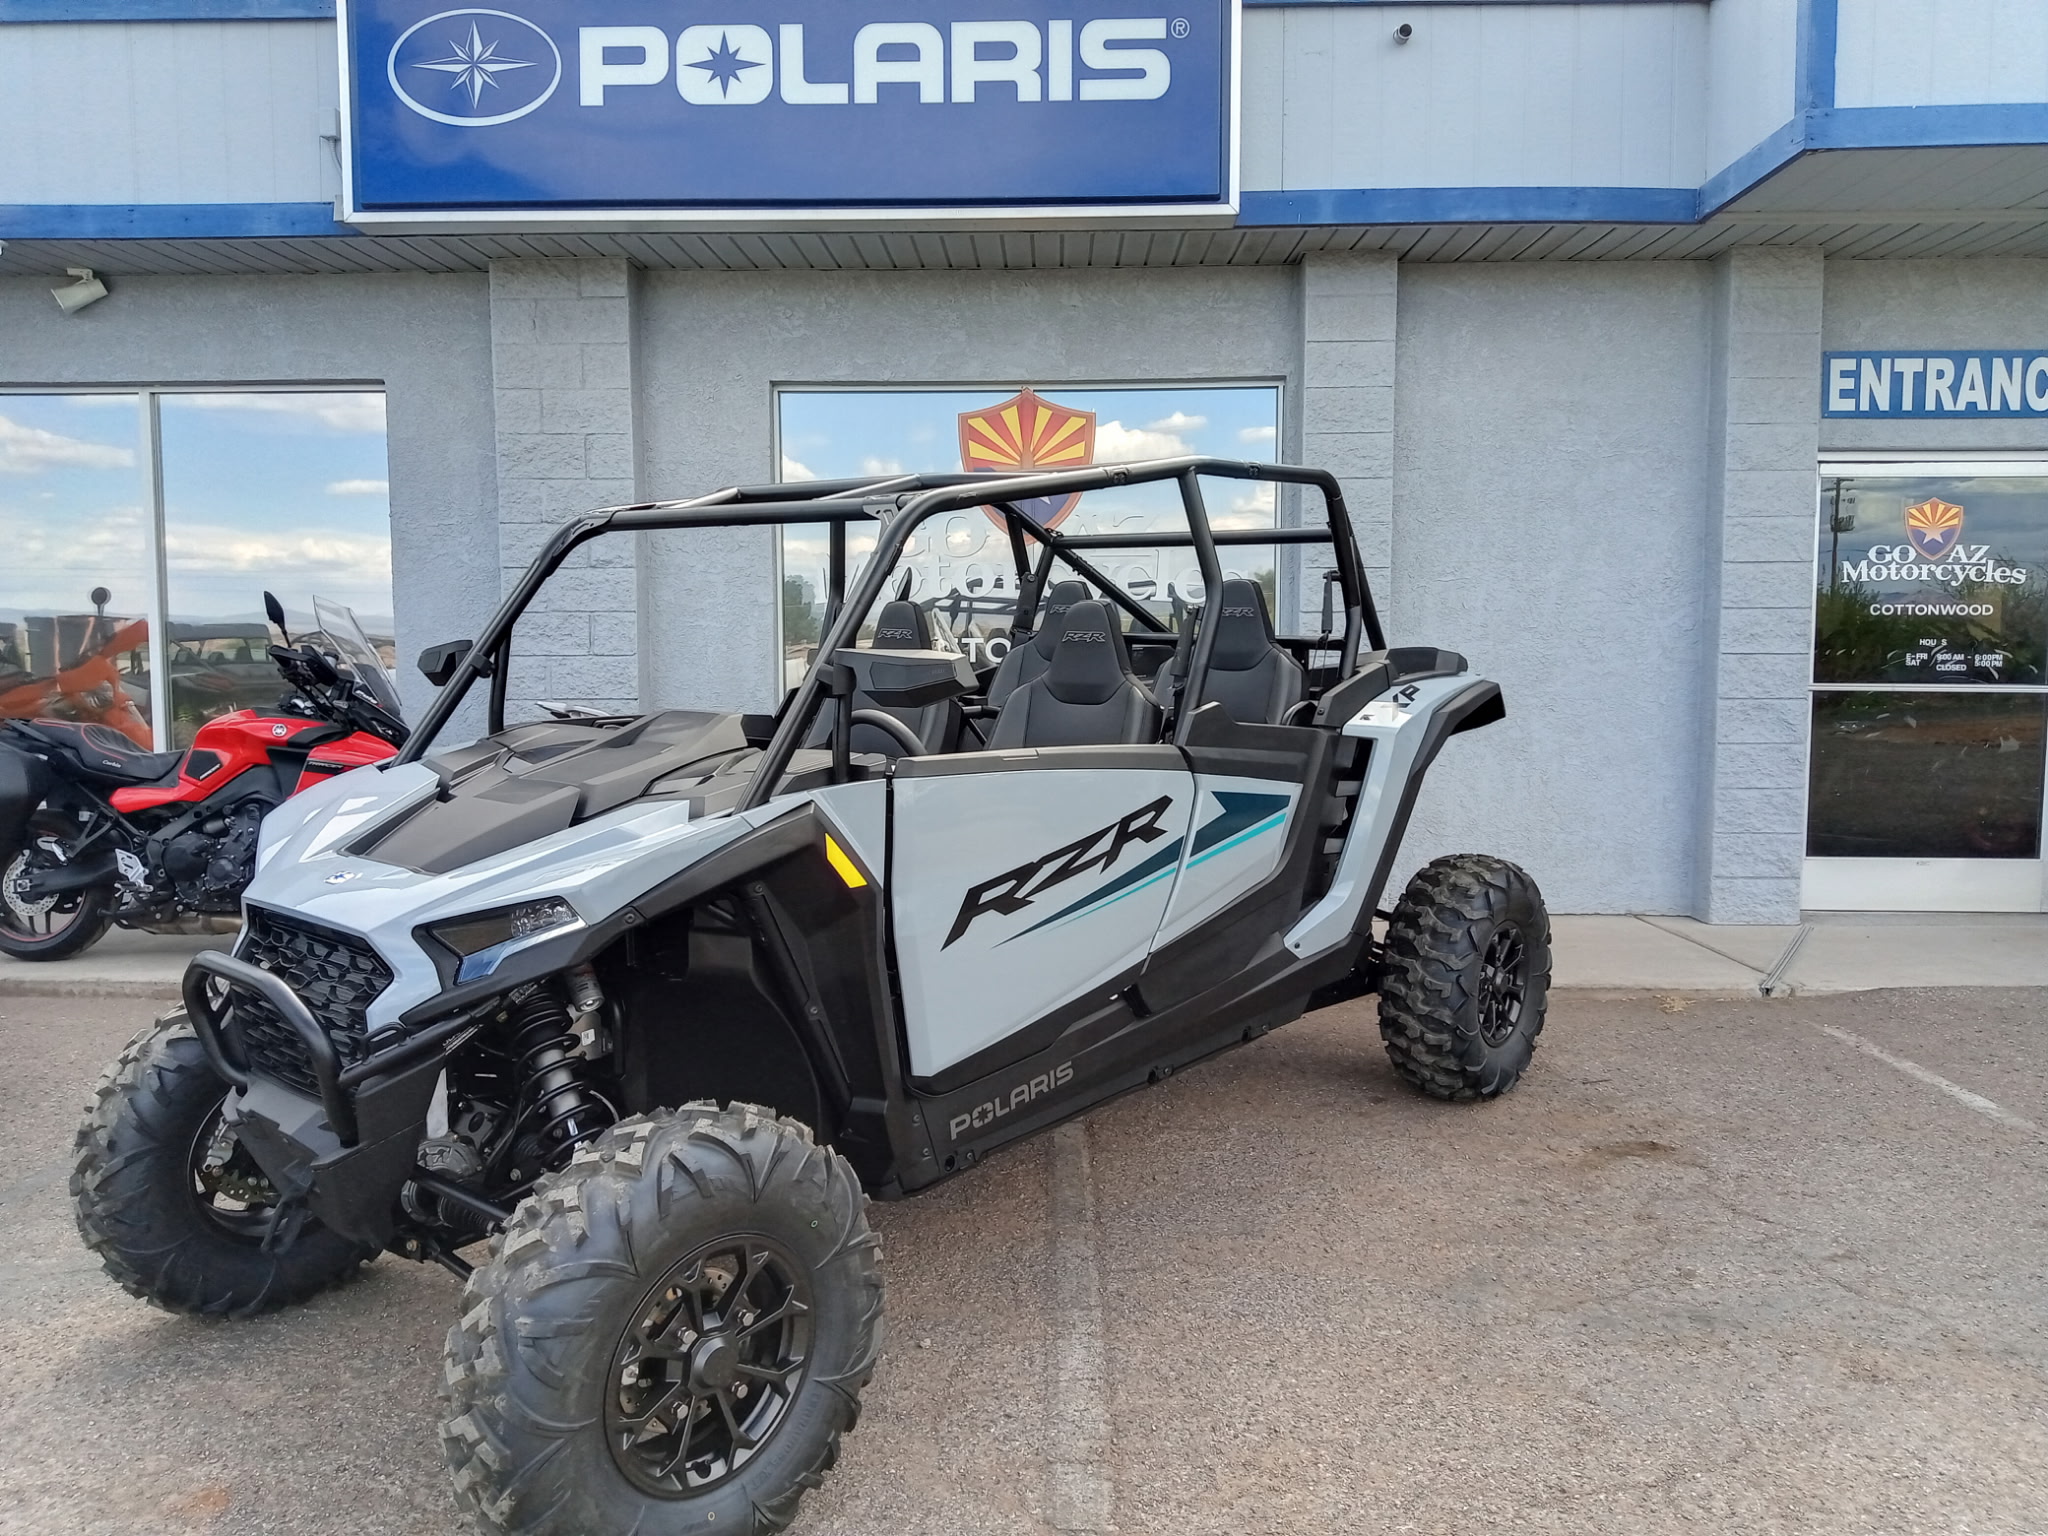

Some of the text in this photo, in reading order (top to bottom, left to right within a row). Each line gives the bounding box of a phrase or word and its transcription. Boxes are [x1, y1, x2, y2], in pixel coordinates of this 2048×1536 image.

[578, 18, 1172, 107] POLARIS
[1867, 544, 1991, 564] GO AZ
[1841, 560, 2027, 586] Motorcycles
[1869, 603, 1994, 616] COTTONWOOD
[1061, 630, 1106, 643] RZR
[1936, 663, 1967, 672] CLOSED
[940, 795, 1174, 951] RZR
[949, 1061, 1075, 1141] POLARIS
